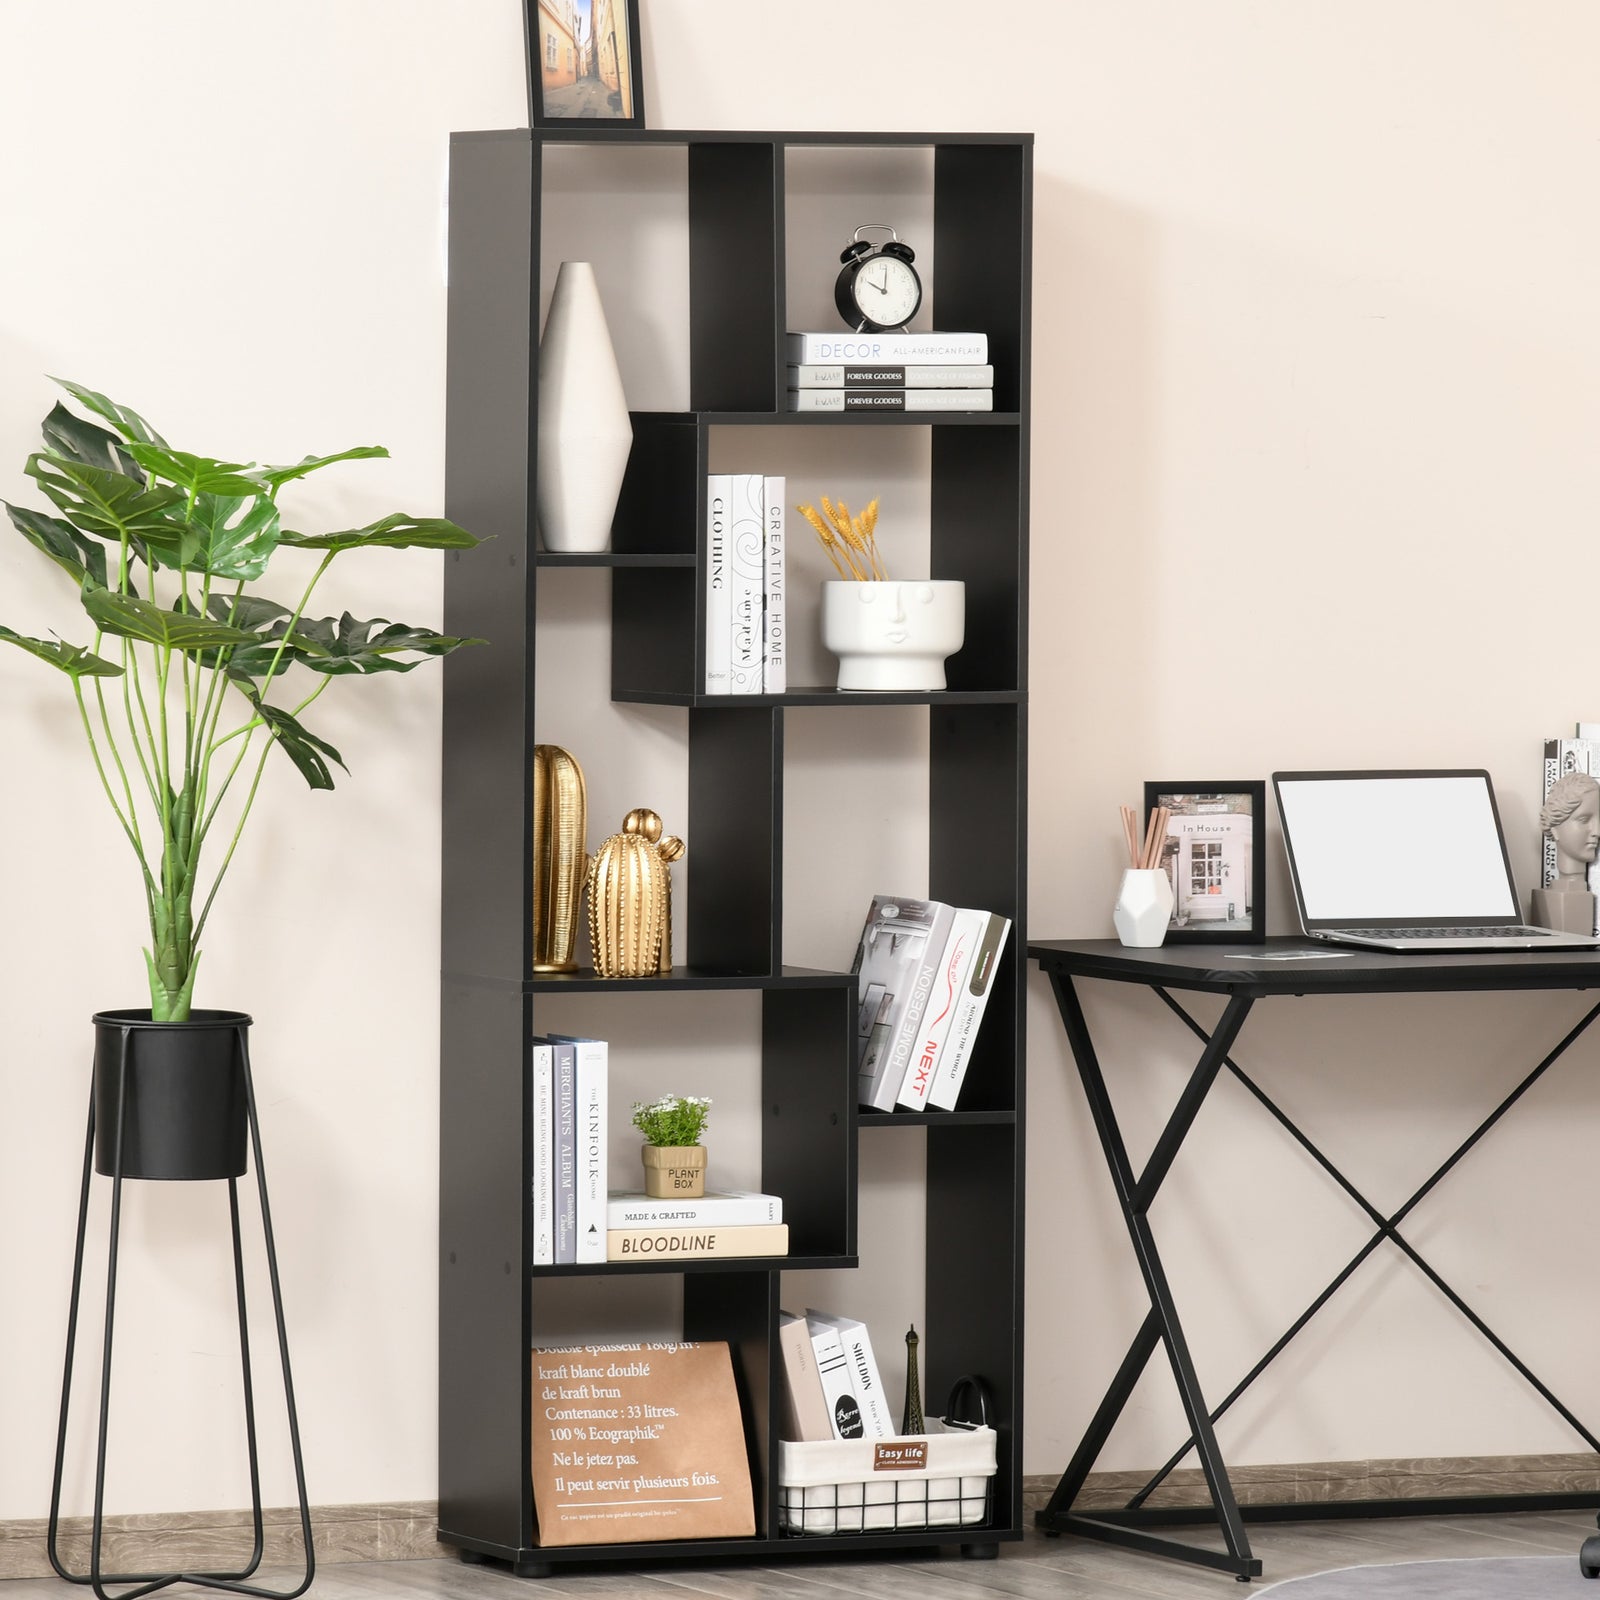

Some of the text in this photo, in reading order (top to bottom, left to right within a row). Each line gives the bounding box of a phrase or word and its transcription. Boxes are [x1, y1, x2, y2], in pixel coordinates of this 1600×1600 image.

[820, 343, 881, 358] DECOR
[847, 372, 902, 380] FOREVER GODDESS
[847, 397, 902, 405] FOREVER GODDESS
[712, 497, 724, 590] CLOTHING
[770, 506, 782, 666] CREATIVE HOME
[741, 589, 752, 661] Madame
[1183, 825, 1194, 833] In
[893, 1023, 916, 1067] HOME
[913, 1041, 937, 1096] NEXT
[561, 1057, 571, 1135] MERCHANTS
[589, 1103, 598, 1178] KINFOLK
[562, 1144, 571, 1188] ALBUM
[668, 1169, 700, 1179] PLANT
[674, 1179, 693, 1189] BOX
[625, 1213, 649, 1221] MADE
[659, 1212, 697, 1220] CRAFTED
[622, 1235, 716, 1254] BLOODLINE
[538, 1362, 650, 1380] kraft blanc doublé
[852, 1342, 872, 1391] SHELDON
[542, 1385, 621, 1400] de kraft brun
[545, 1407, 618, 1421] Contenance
[627, 1405, 642, 1419] 33
[644, 1404, 679, 1419] litres.
[550, 1428, 572, 1441] 100
[573, 1427, 587, 1440] %
[552, 1452, 639, 1470] Ne le jetez pas.
[879, 1448, 923, 1460] Easy life
[555, 1471, 720, 1495] Il peut servir plusieurs fois.
